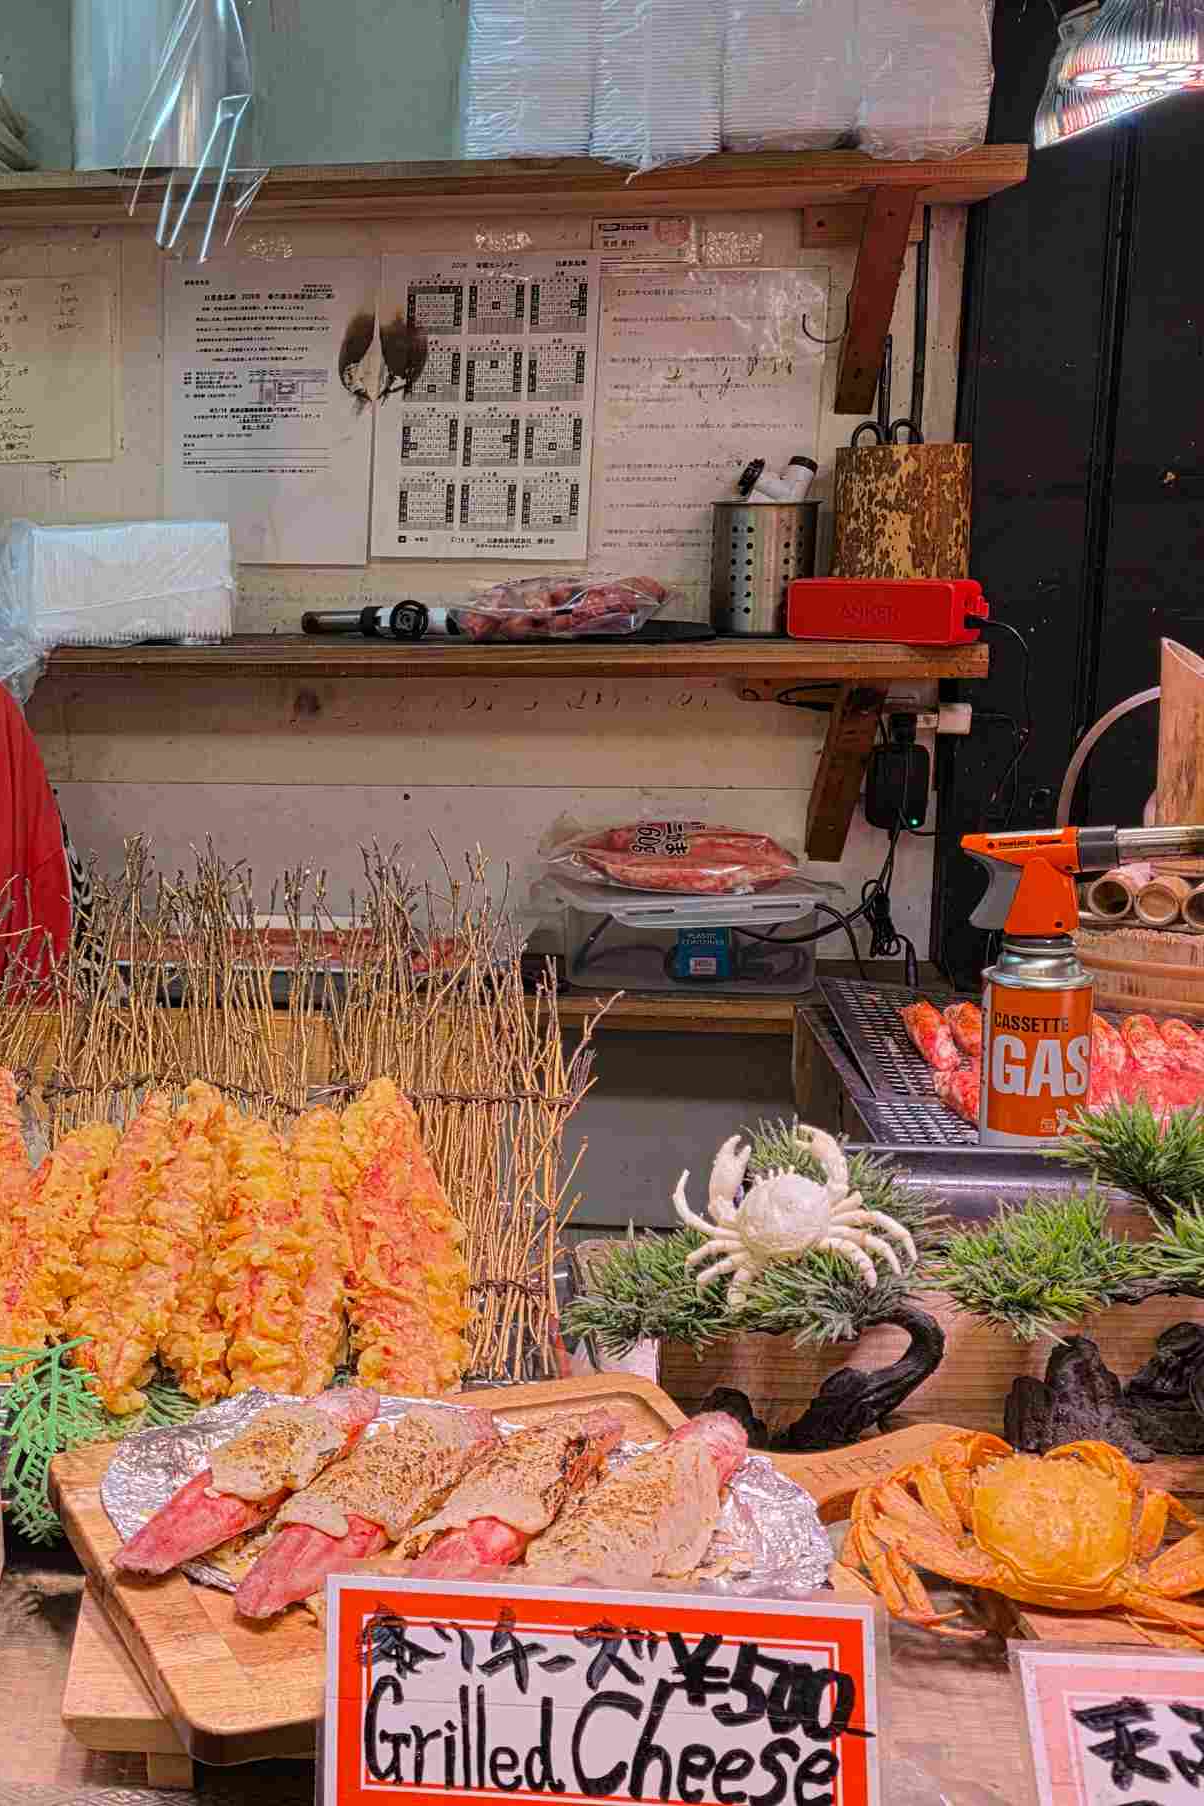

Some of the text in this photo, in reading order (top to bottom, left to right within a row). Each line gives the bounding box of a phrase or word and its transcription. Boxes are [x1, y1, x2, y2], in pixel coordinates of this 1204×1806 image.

[995, 1012, 1069, 1033] CASSETTE
[991, 1034, 1090, 1097] GAS
[363, 1674, 841, 1806] Grilled Cheese
